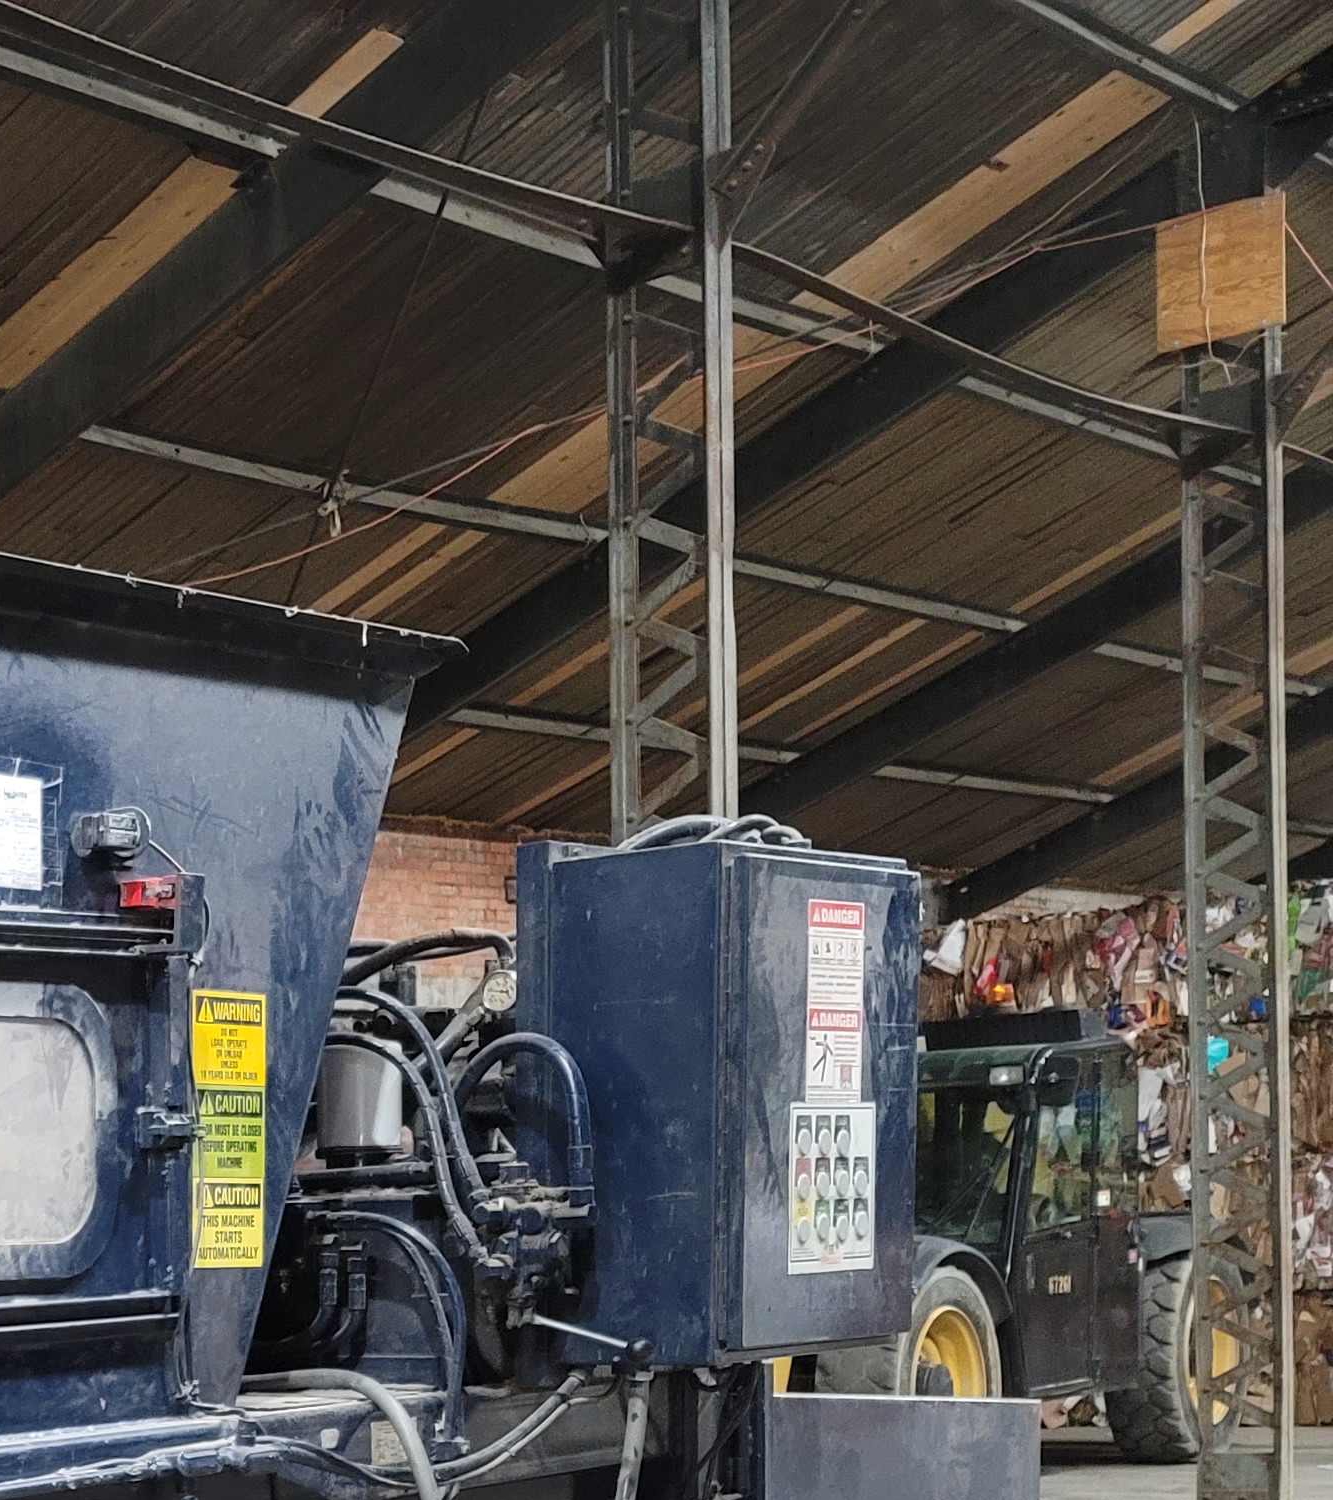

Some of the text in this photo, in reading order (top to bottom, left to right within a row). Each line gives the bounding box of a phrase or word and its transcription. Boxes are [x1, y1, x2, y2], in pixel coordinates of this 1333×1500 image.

[821, 907, 860, 925] DANGER
[213, 1001, 261, 1022] WARNING
[819, 1012, 858, 1028] DANGER
[227, 1039, 247, 1049] OPERATE
[208, 1070, 223, 1079] YEARS
[215, 1094, 260, 1114] CAUTION
[214, 1124, 230, 1136] MUST
[232, 1124, 239, 1136] BE
[241, 1124, 261, 1137] CLOSED
[226, 1140, 257, 1153] OPERATING
[217, 1156, 243, 1169] MACHINE
[214, 1187, 259, 1206] CAUTION
[202, 1215, 255, 1228] THIS MACHINE
[214, 1230, 242, 1243] STARTS
[198, 1246, 258, 1260] AUTOMATICALLY
